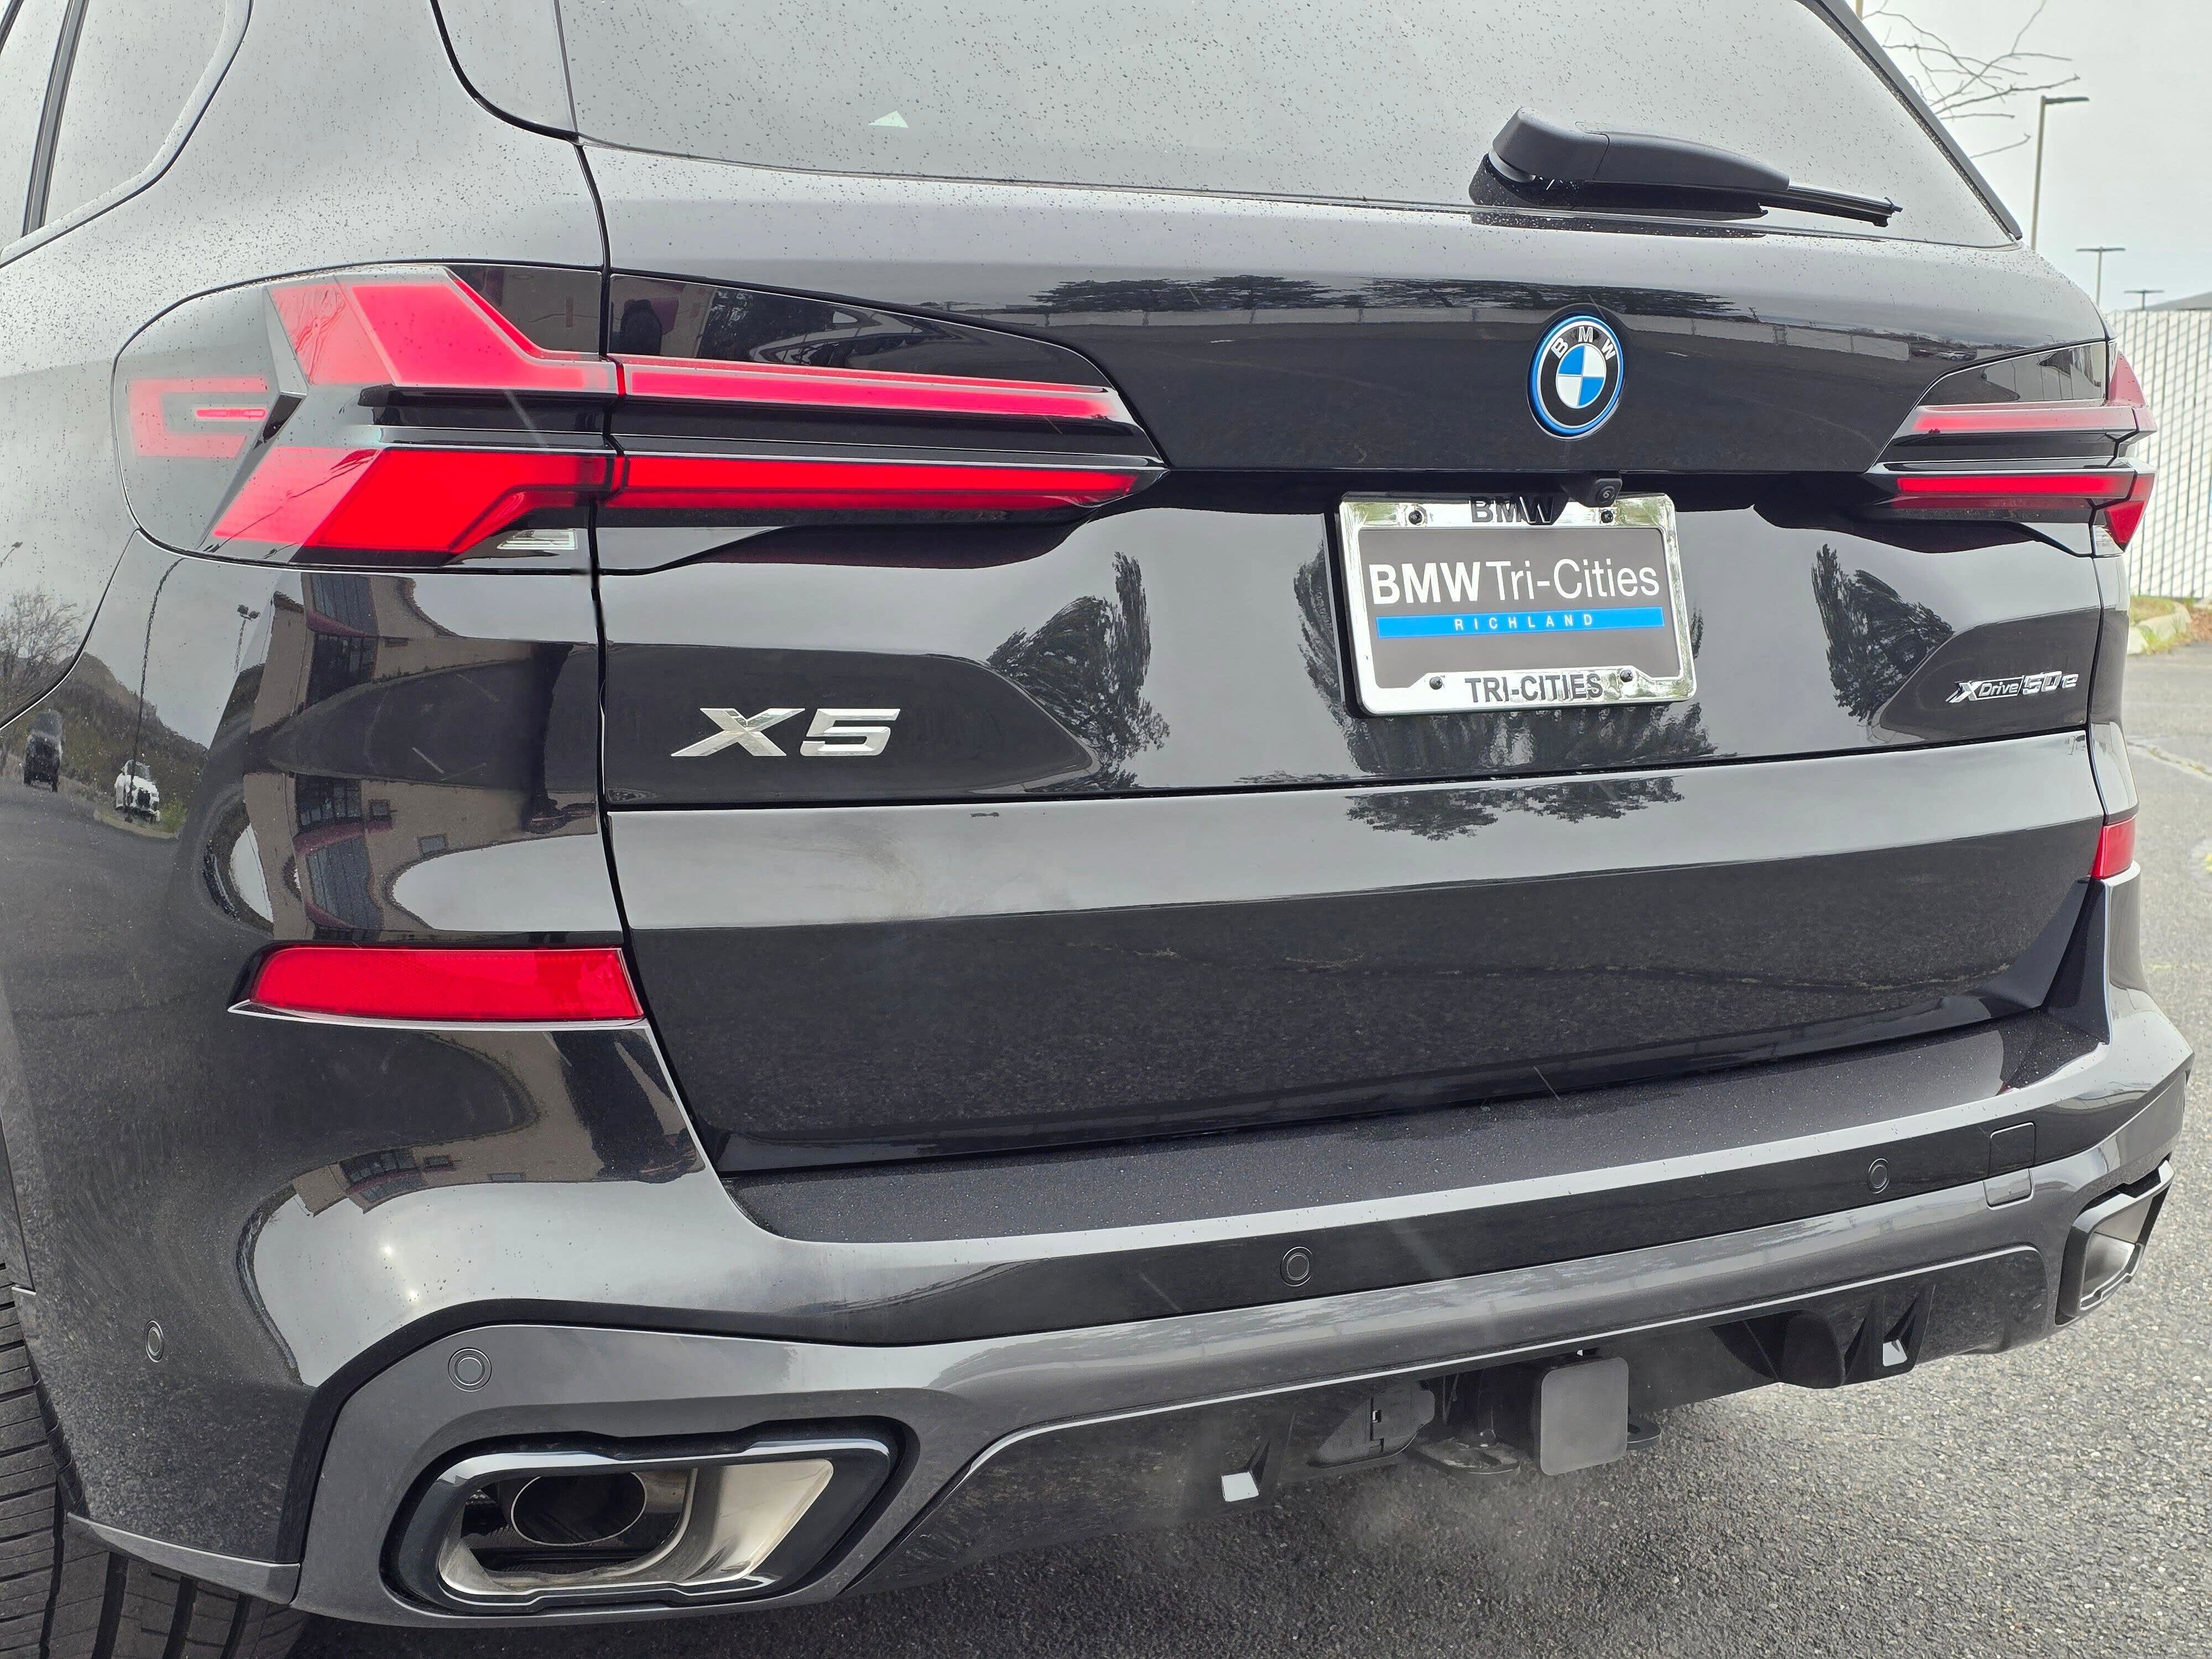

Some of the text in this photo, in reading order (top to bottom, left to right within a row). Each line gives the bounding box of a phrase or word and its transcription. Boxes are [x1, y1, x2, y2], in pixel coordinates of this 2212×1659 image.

[1551, 326, 1616, 361] BMW
[1469, 496, 1553, 524] BMW
[1369, 558, 1660, 604] BMW Tri-Cities
[1454, 613, 1593, 631] RICHLAND
[1464, 673, 1603, 702] TRI-CITIES
[671, 707, 901, 757] X5
